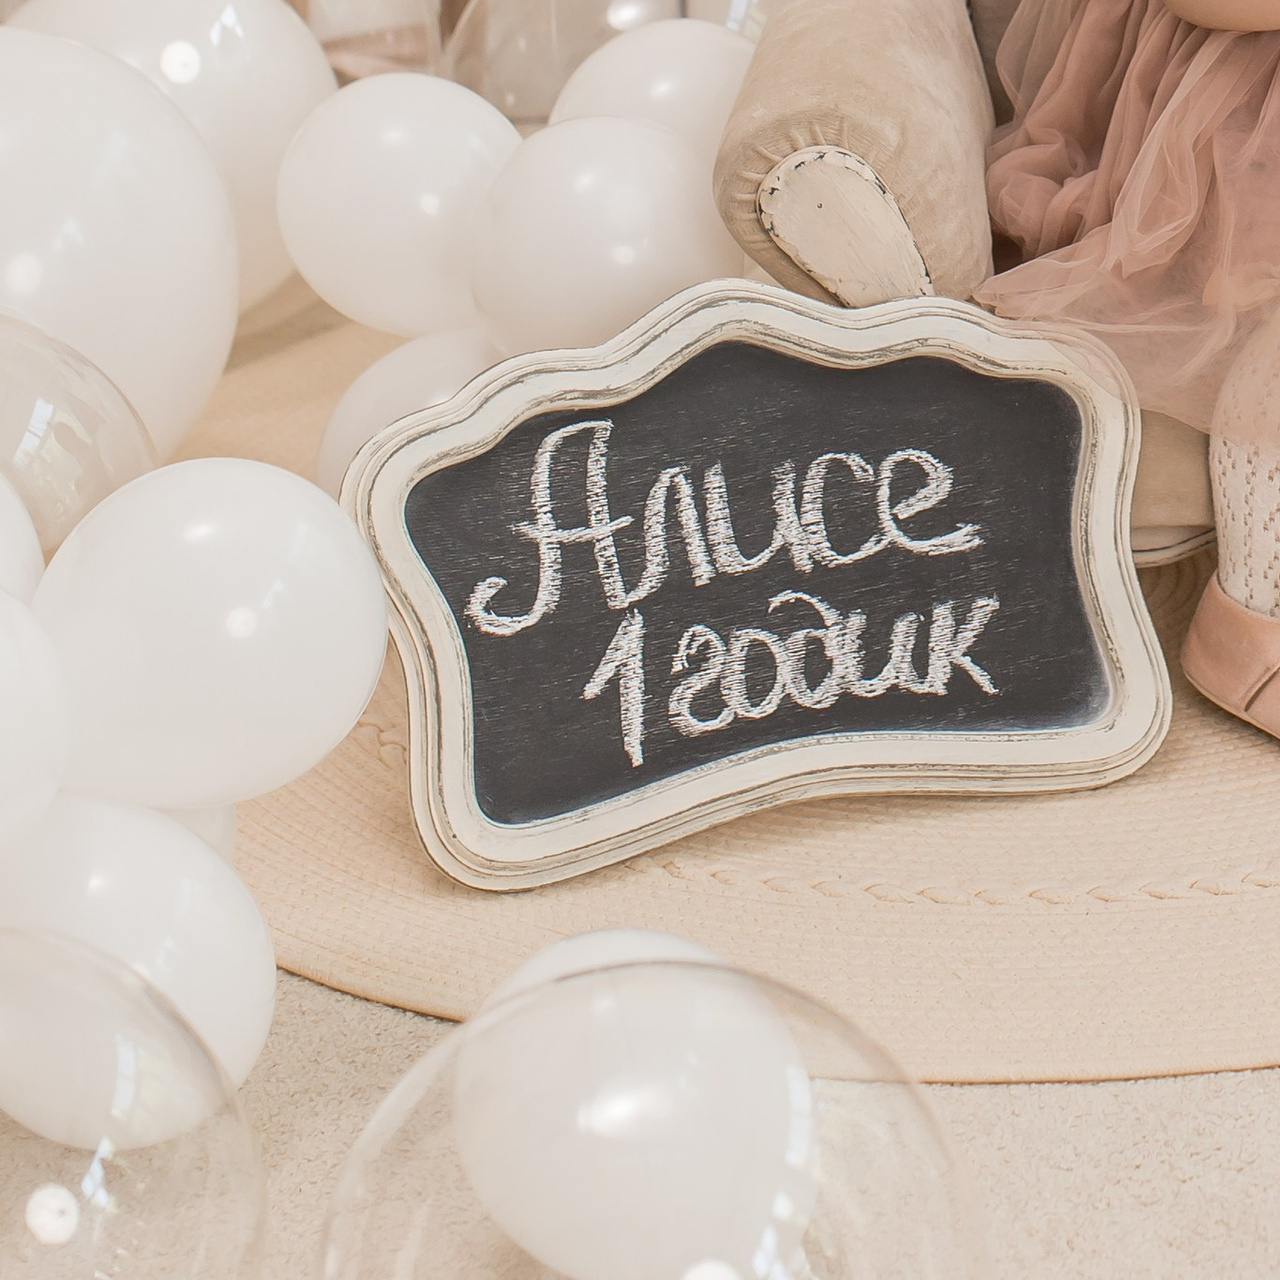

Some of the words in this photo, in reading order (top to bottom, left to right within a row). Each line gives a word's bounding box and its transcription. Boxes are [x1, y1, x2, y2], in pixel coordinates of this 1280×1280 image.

[466, 419, 984, 635] Алисе
[581, 608, 645, 768] 1
[668, 590, 1000, 738] годик
